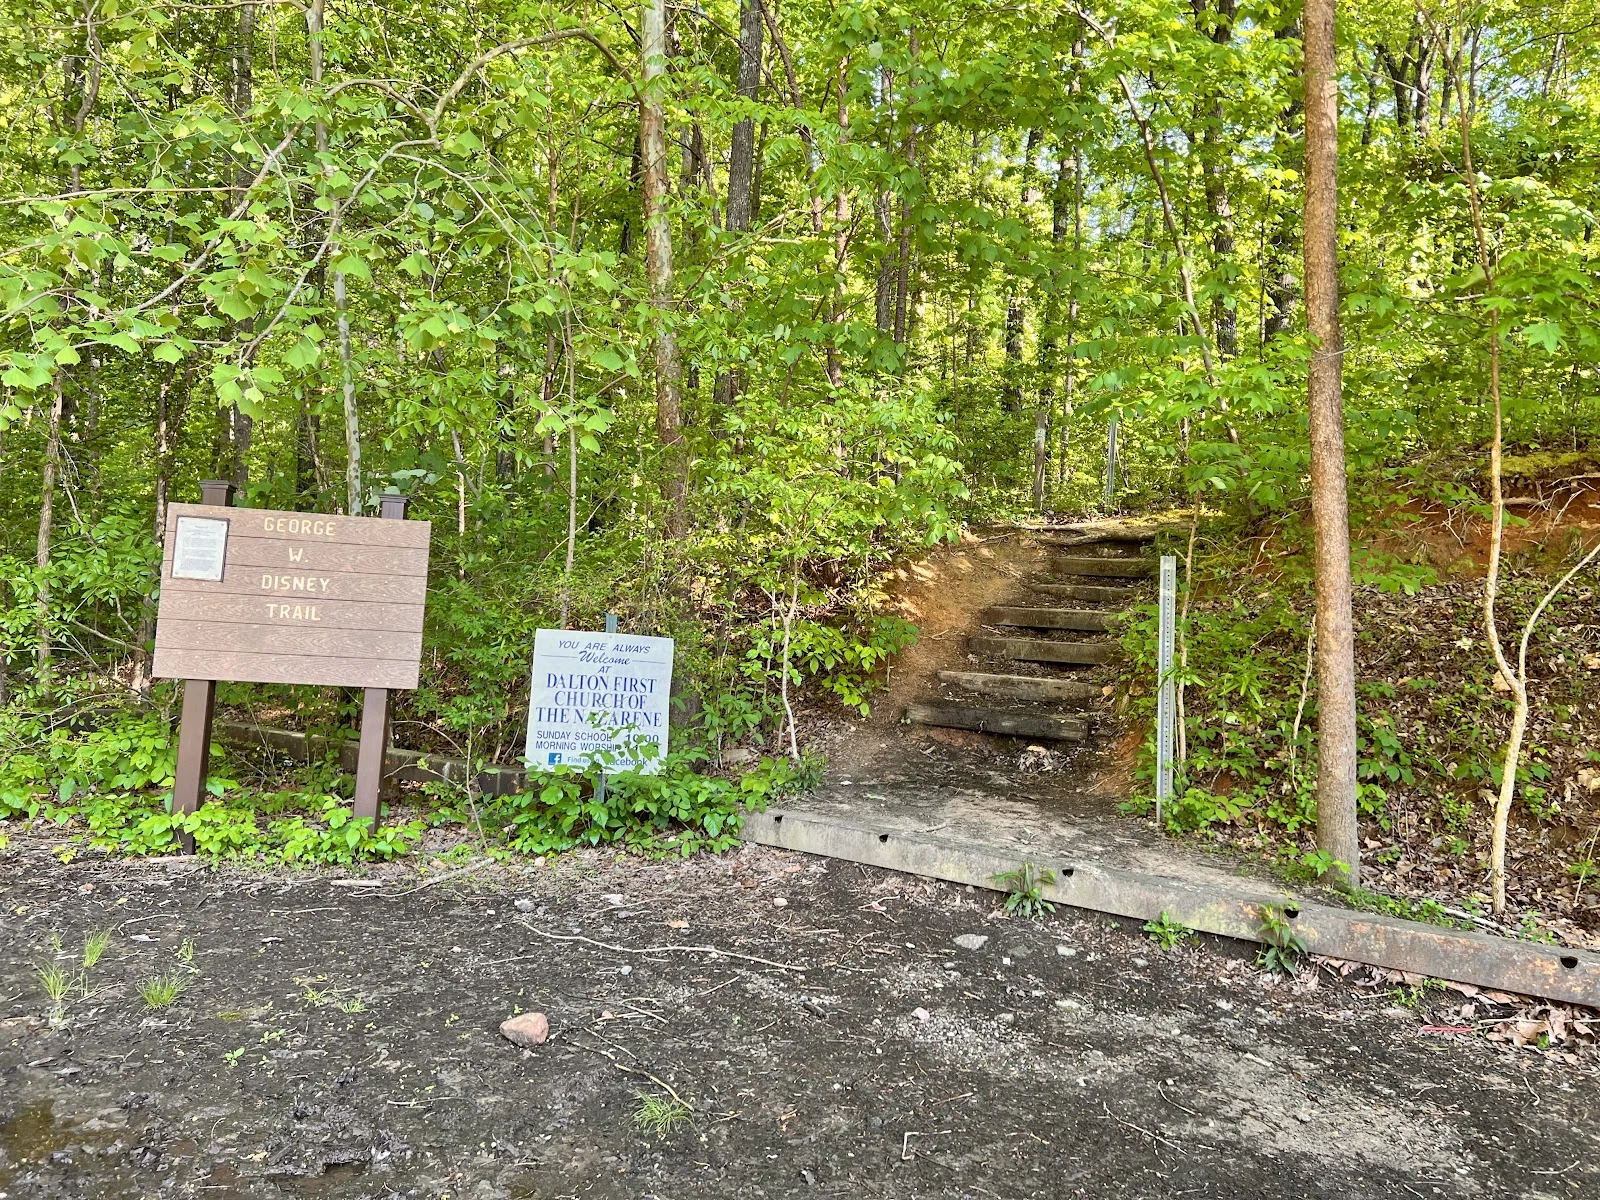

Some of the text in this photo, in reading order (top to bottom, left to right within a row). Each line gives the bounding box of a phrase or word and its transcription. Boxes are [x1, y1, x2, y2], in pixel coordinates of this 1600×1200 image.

[264, 517, 336, 536] GEORGE
[289, 547, 309, 562] W.
[261, 574, 330, 592] DISNEY
[266, 603, 321, 621] TRAIL
[559, 640, 651, 654] YOU ARE ALWAYS
[579, 650, 631, 665] Welcome
[597, 665, 612, 674] AT
[546, 673, 657, 694] DALTON FIRST
[554, 690, 648, 710] CHURCH OF
[535, 706, 662, 728] THE NZARENE
[536, 730, 572, 740] SUNDAY
[574, 732, 612, 742] SCHOOL
[535, 741, 577, 751] MORNING
